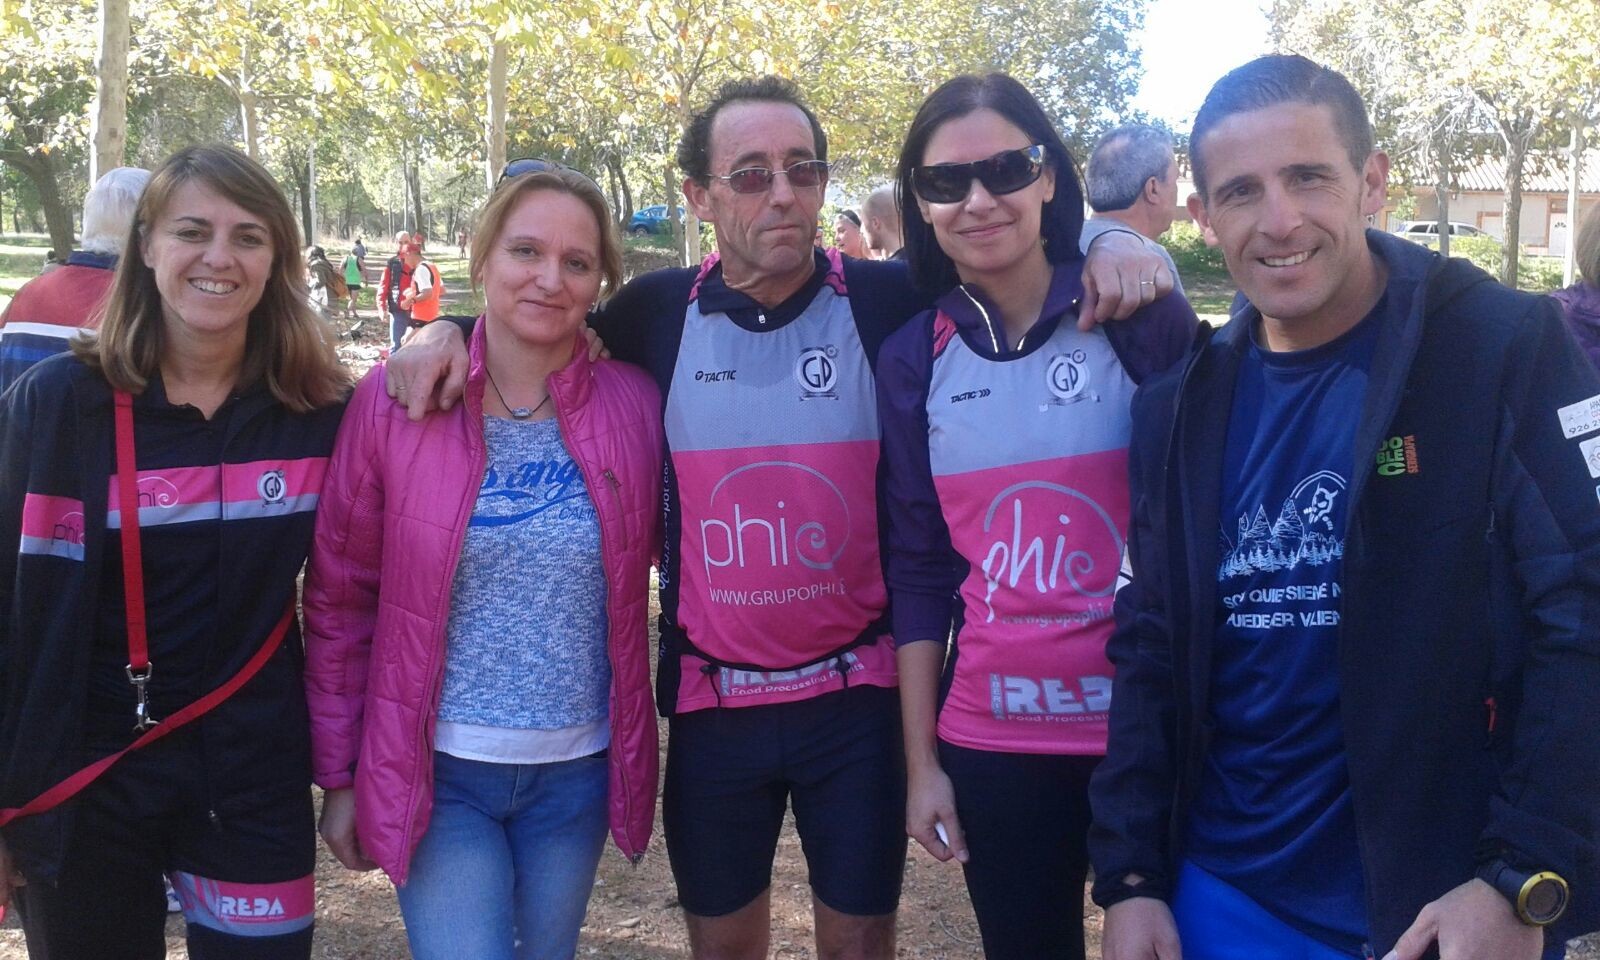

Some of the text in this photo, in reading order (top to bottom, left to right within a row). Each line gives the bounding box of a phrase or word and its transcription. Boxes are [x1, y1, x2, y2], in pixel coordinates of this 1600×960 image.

[705, 370, 736, 383] TACTIC
[951, 391, 976, 403] TACTIC
[1569, 424, 1590, 434] 926
[731, 686, 762, 696] Food
[829, 662, 865, 678] Pts
[1007, 714, 1109, 722] Food Processi
[221, 896, 285, 916] REDA
